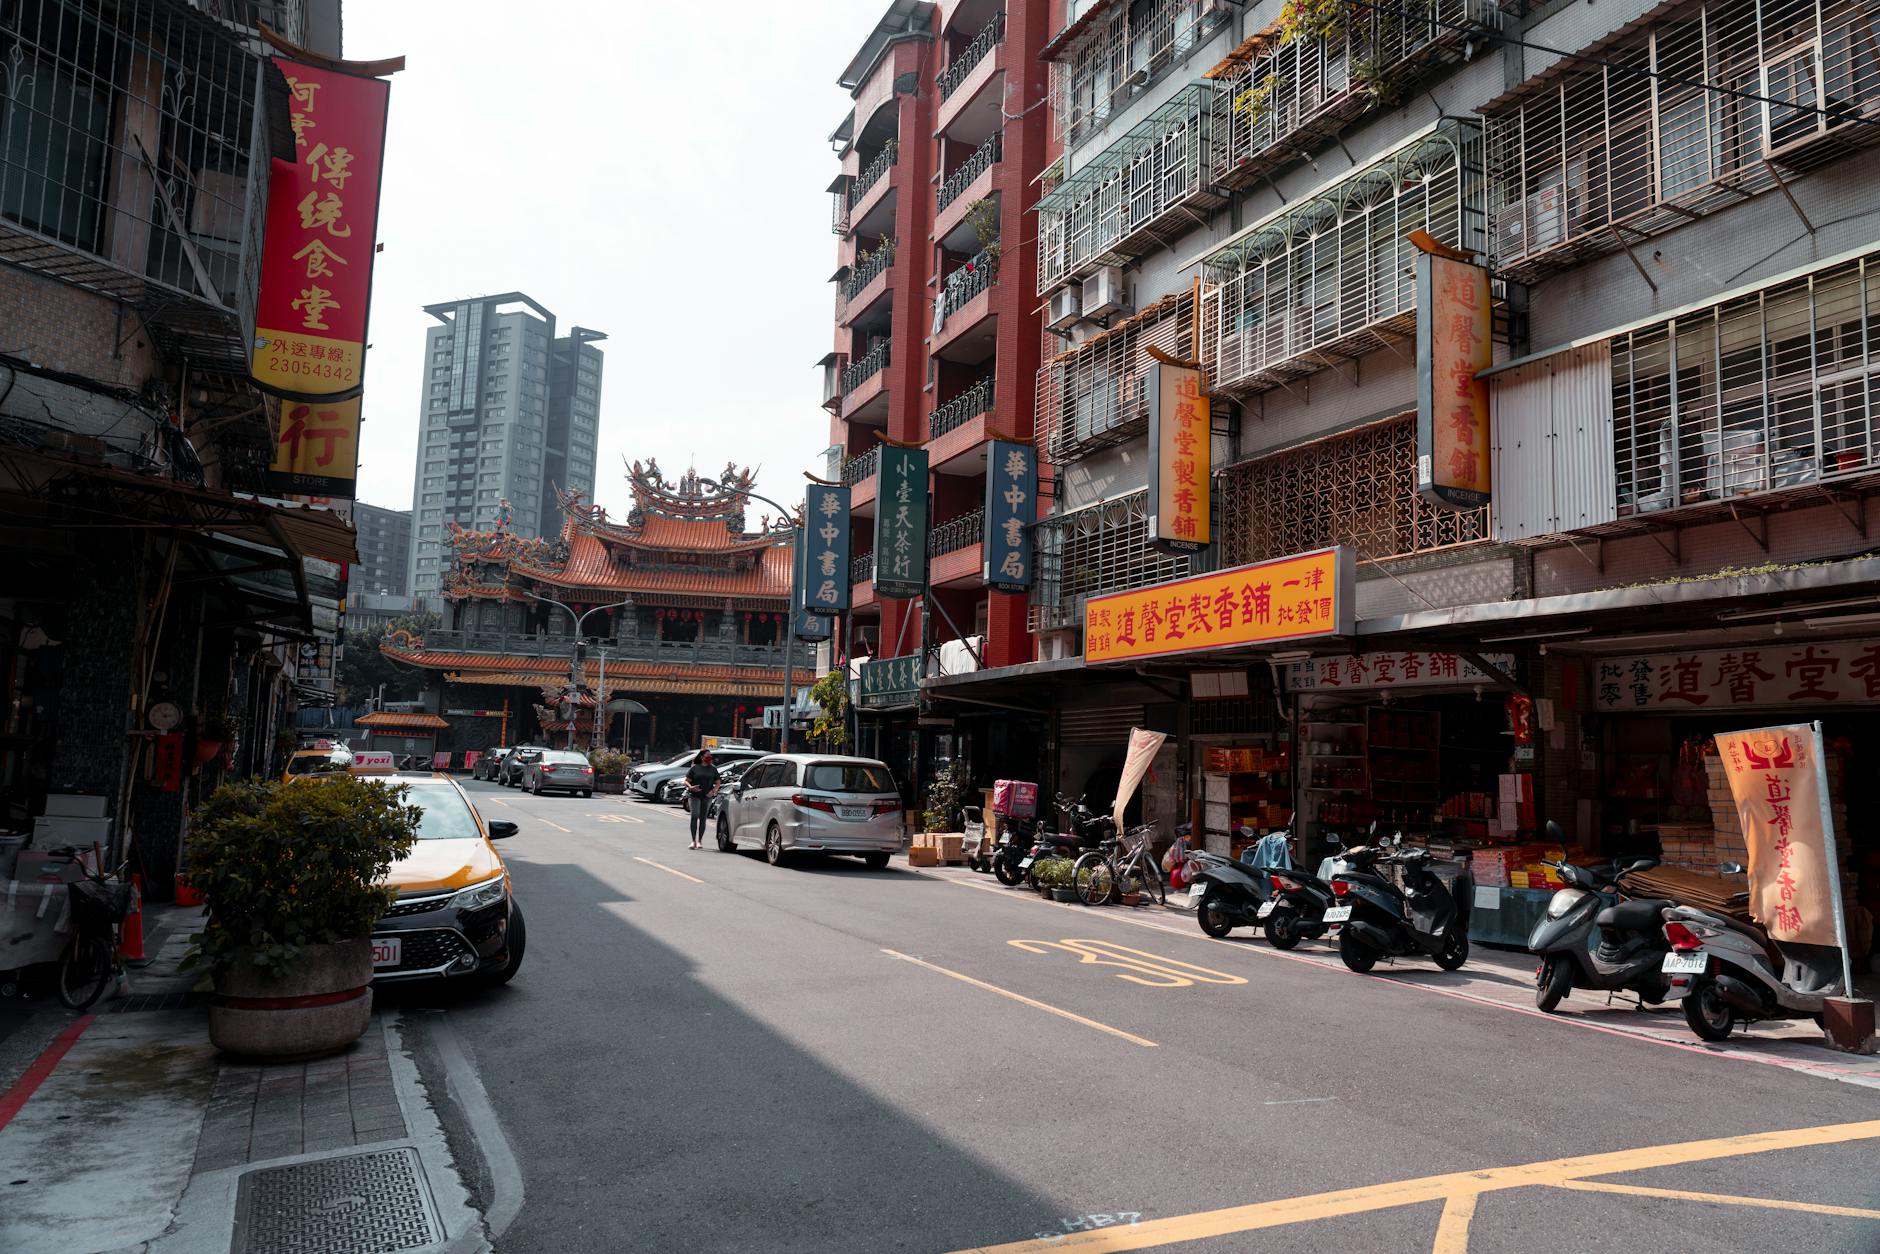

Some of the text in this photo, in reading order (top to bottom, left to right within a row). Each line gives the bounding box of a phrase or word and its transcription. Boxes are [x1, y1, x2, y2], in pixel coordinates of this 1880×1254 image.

[269, 357, 353, 381] 23054342
[279, 404, 352, 467] 行
[1447, 487, 1481, 501] INCENSE
[1000, 450, 1028, 580] 華中書局
[815, 492, 842, 605] 華中書局
[1169, 541, 1199, 550] INCENSE
[1277, 597, 1332, 626] 批發價
[367, 755, 392, 765] yoxi
